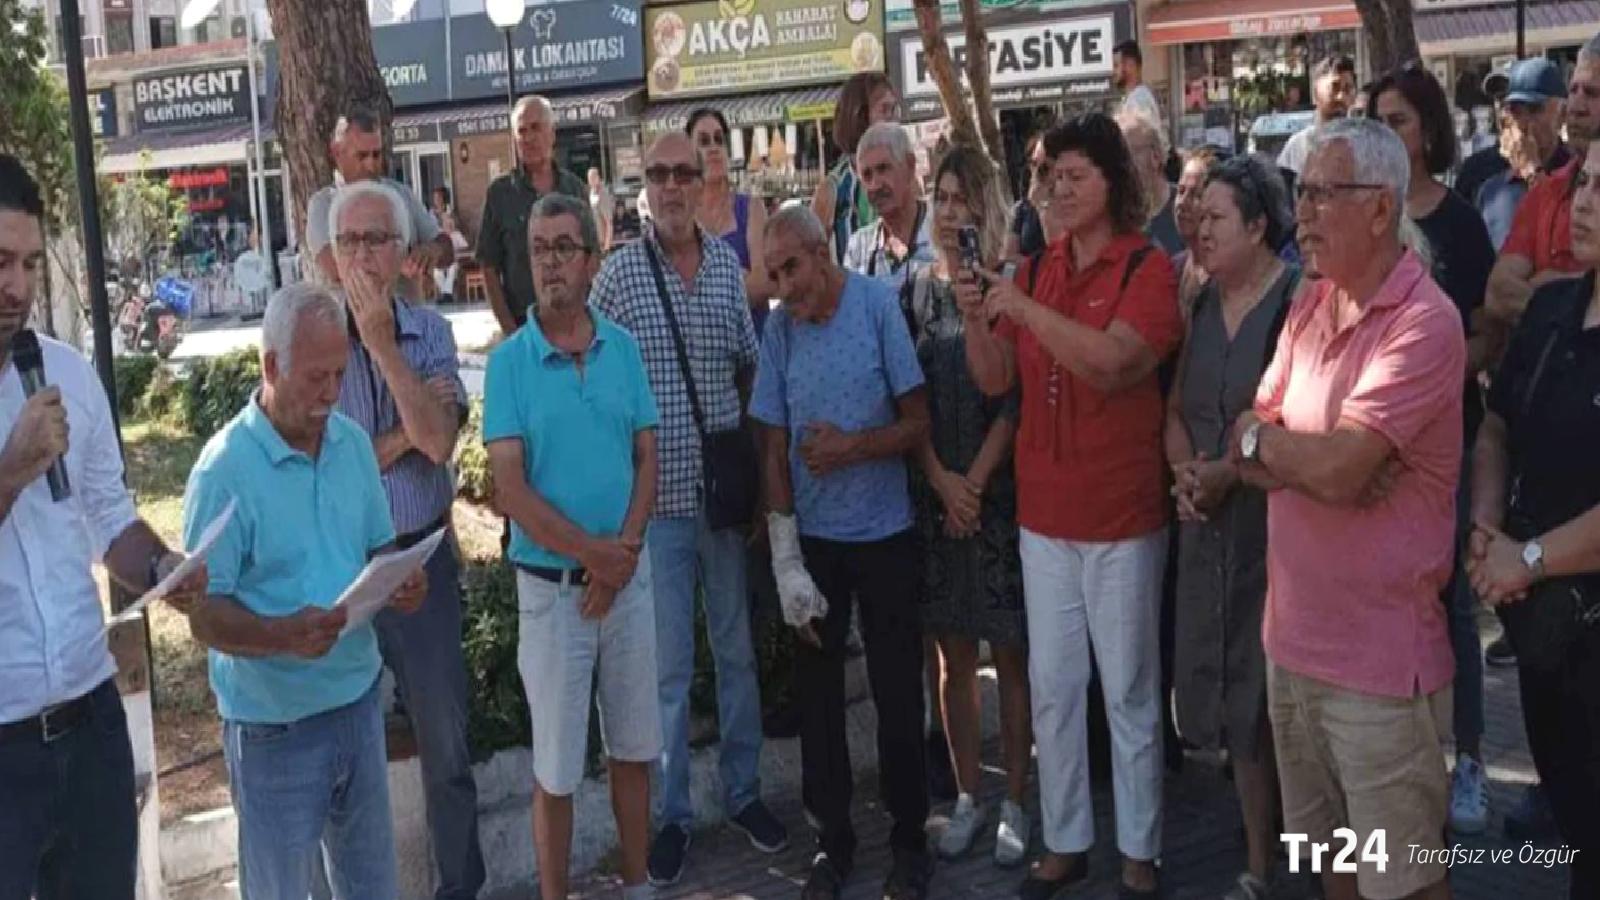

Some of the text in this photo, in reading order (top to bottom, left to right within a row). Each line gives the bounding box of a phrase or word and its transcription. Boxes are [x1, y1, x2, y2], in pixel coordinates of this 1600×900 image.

[610, 3, 638, 27] 7/24
[689, 13, 771, 58] AKÇA
[532, 35, 626, 69] LOKANTASI
[135, 68, 242, 104] BAŞKENT
[380, 63, 427, 87] GORTA
[143, 96, 234, 123] ELEKTRONİK
